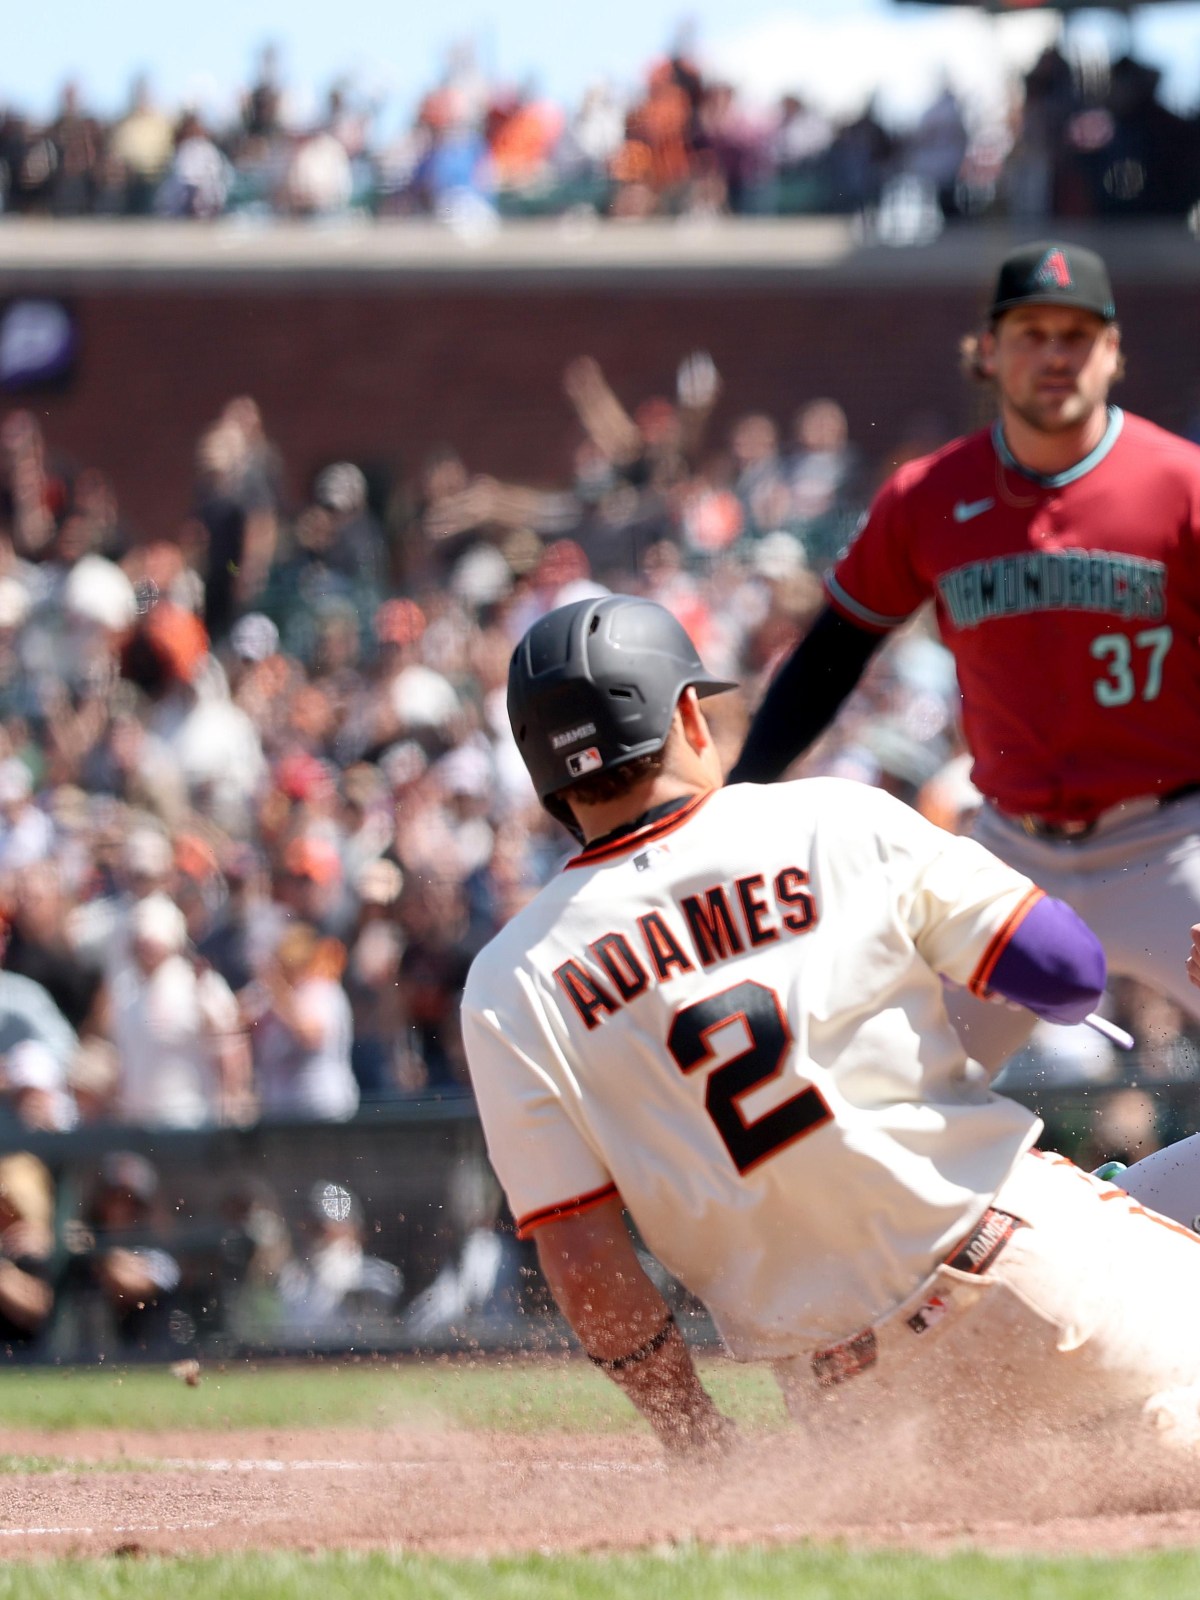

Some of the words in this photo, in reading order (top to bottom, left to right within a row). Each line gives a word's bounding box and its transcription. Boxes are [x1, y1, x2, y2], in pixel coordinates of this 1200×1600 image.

[1089, 625, 1174, 708] 37
[552, 866, 818, 1031] ADAMES
[666, 978, 836, 1178] 2
[965, 1210, 1014, 1266] ADAMES
